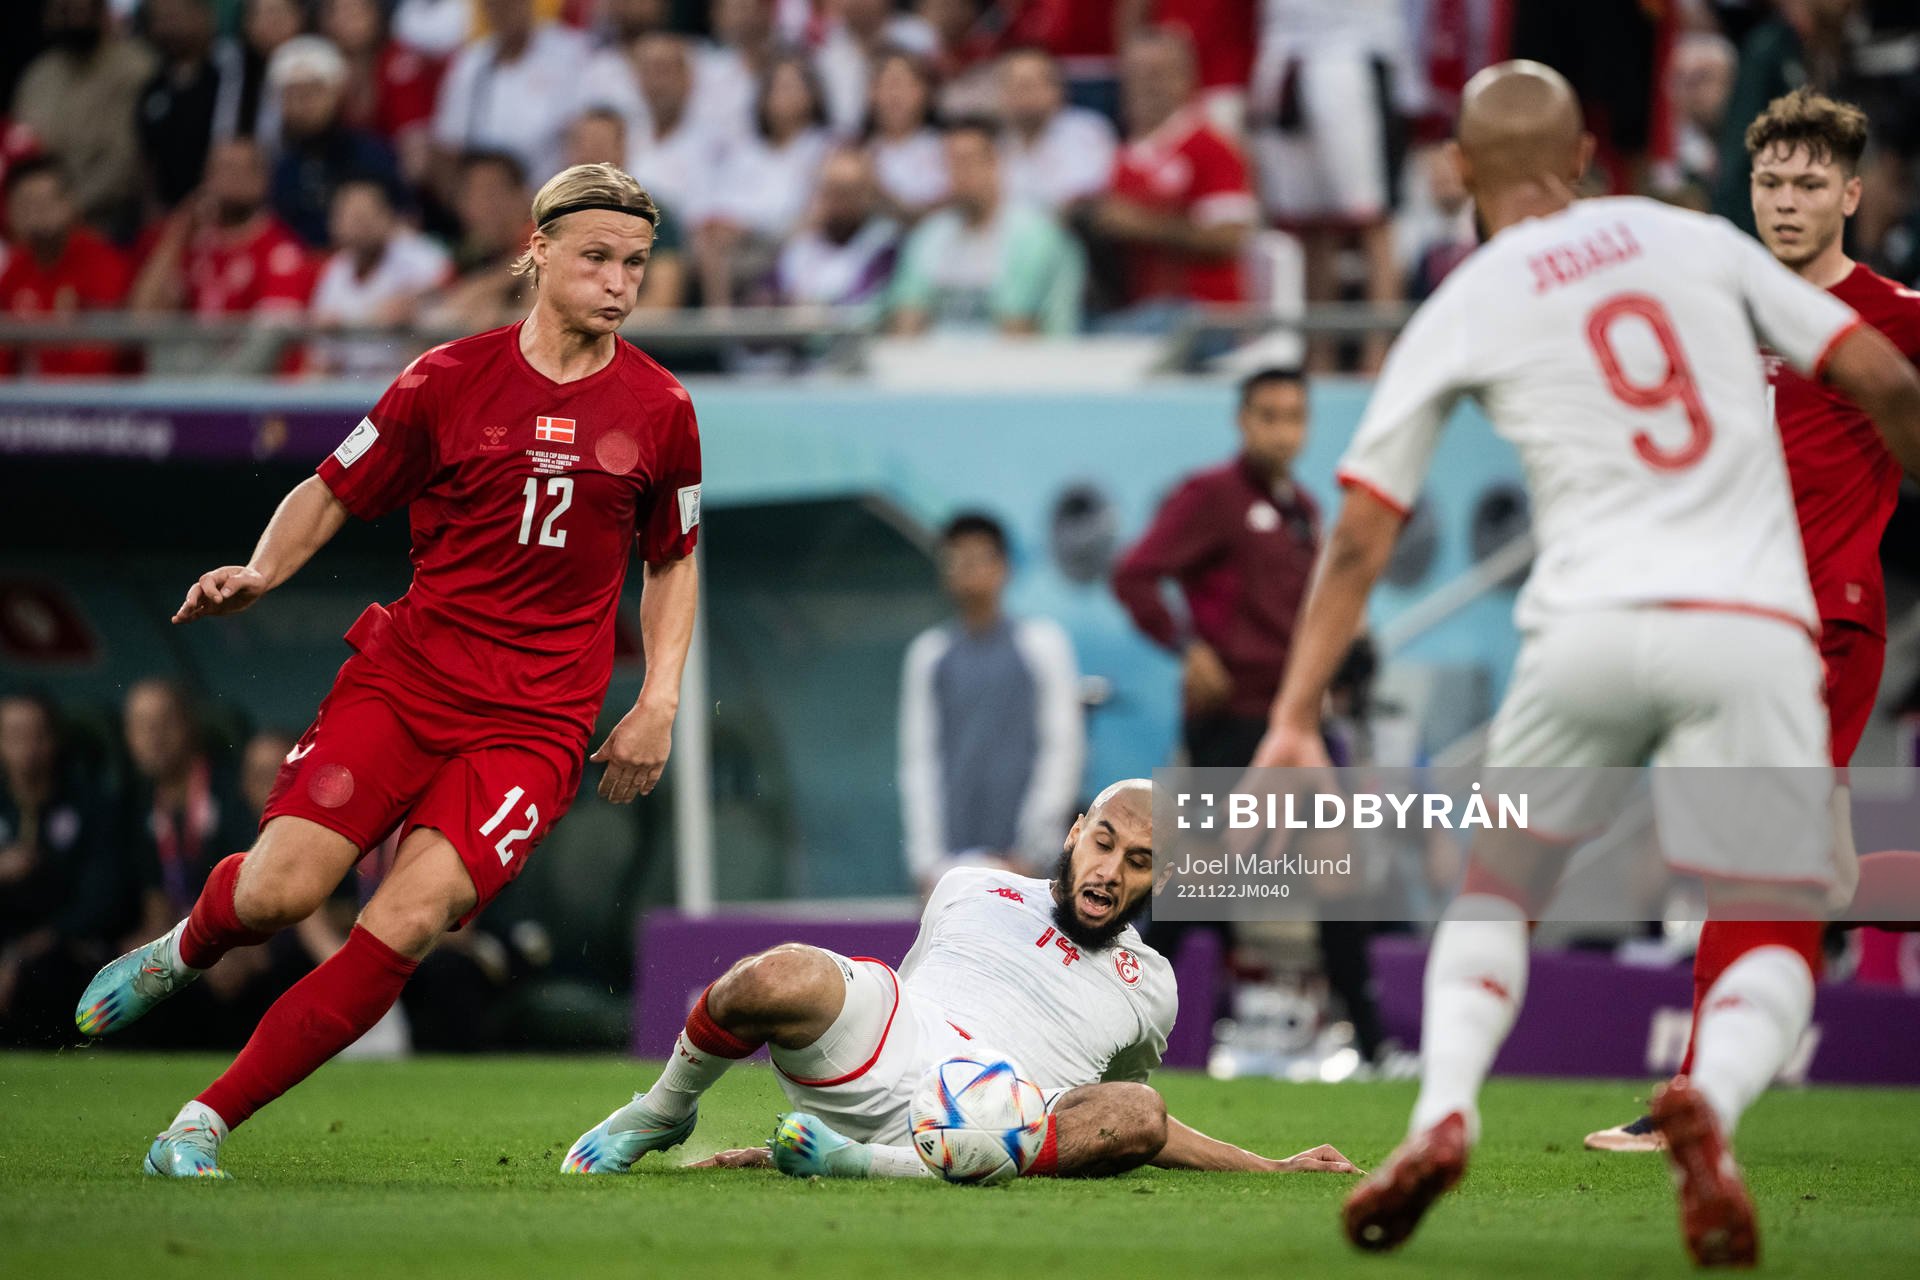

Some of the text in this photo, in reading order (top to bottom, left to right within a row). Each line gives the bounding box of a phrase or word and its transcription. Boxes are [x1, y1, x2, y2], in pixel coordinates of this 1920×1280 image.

[1584, 291, 1713, 475] 9
[535, 450, 549, 458] WORLD
[518, 477, 575, 548] 12
[478, 785, 539, 867] 12
[1035, 927, 1080, 966] 14
